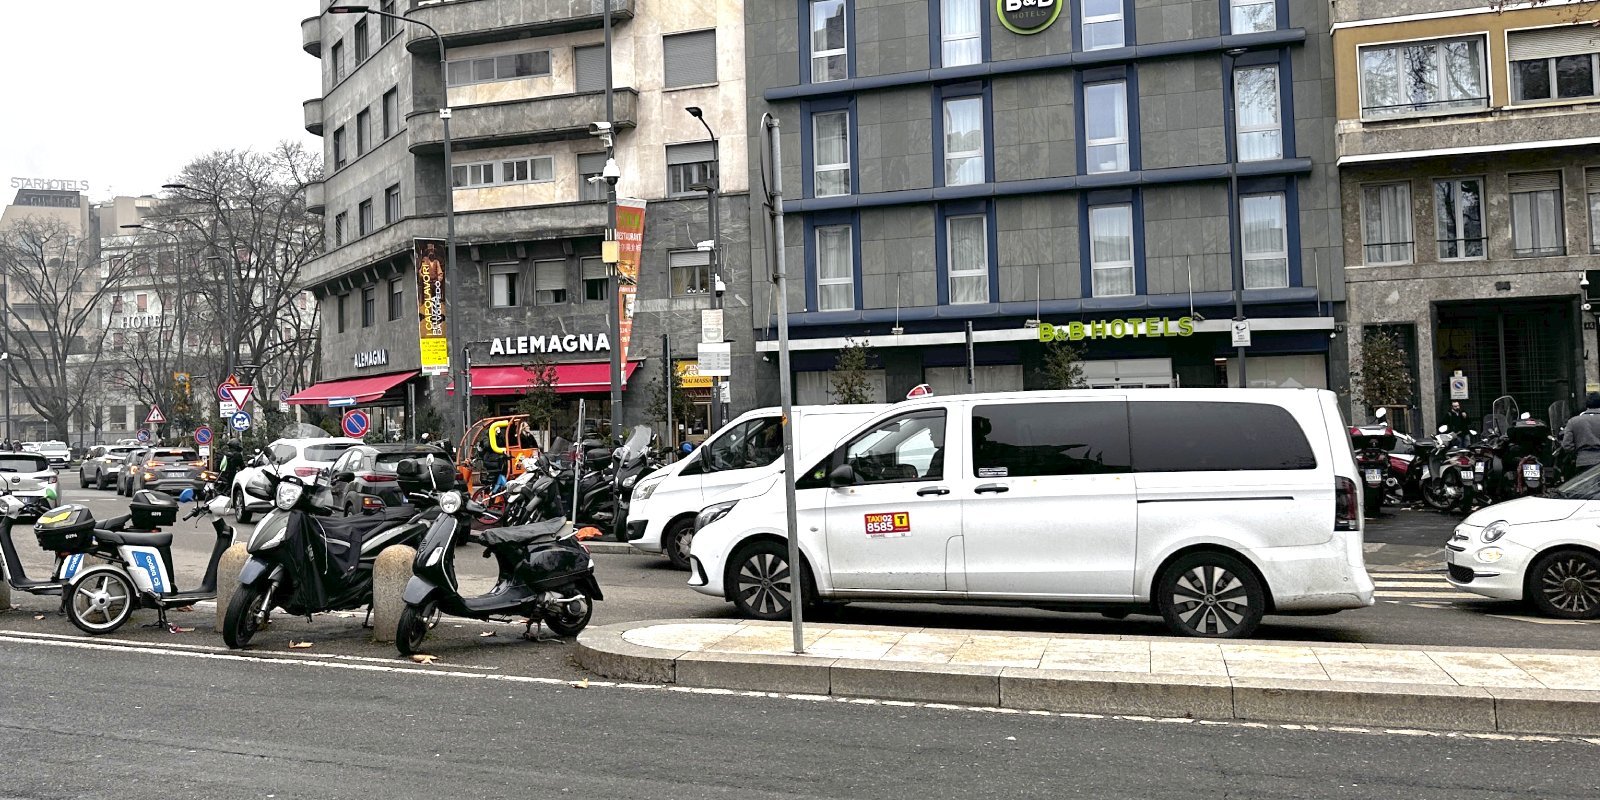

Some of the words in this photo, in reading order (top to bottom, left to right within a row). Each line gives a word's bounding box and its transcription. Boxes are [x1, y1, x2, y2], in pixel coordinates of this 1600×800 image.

[1012, 10, 1047, 20] HOTELS
[10, 176, 90, 191] STARHOTELS
[423, 264, 432, 330] CAPOLAVORI
[434, 280, 442, 322] VOLPEDO
[120, 313, 172, 329] HOTEL
[1039, 321, 1085, 343] B&B
[1090, 316, 1194, 340] HOTELS
[489, 332, 611, 356] ALEMAGNA
[354, 348, 387, 368] ALEMAGNA
[867, 521, 894, 532] 8585
[896, 515, 905, 525] T
